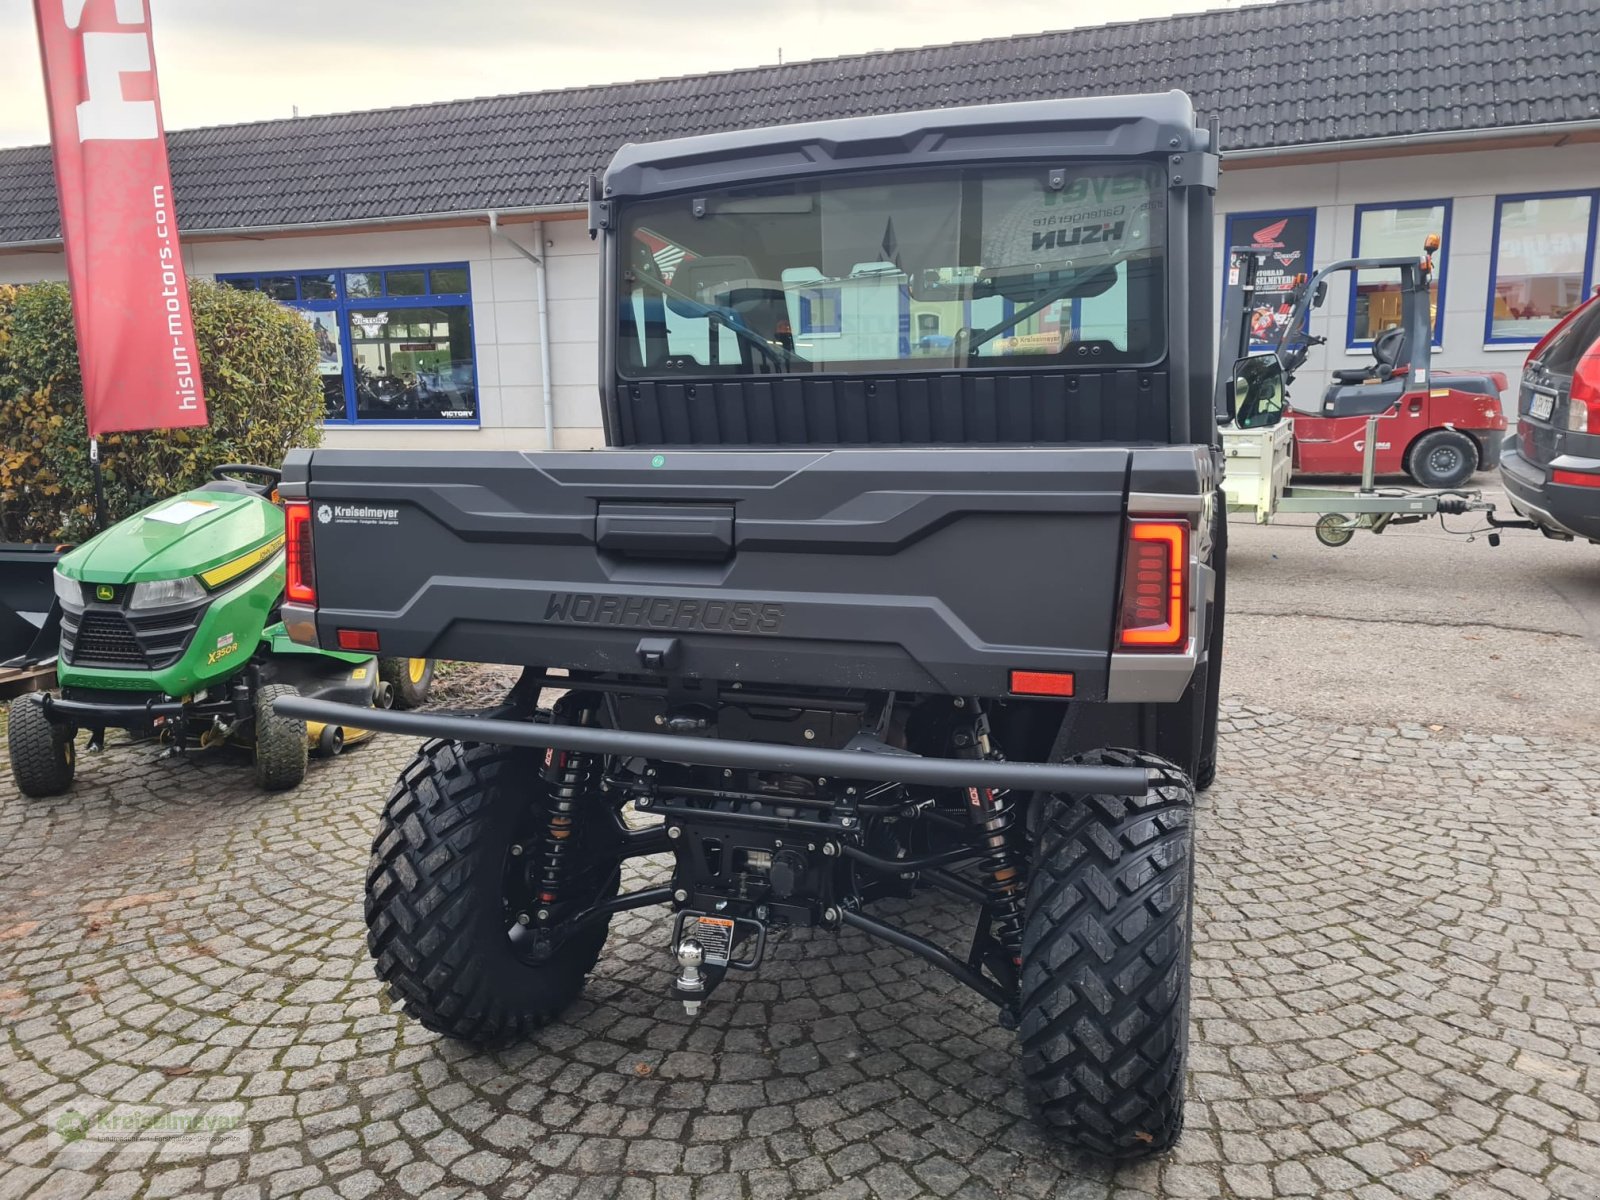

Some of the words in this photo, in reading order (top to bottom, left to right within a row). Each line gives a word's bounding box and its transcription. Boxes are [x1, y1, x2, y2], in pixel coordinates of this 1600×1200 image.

[153, 185, 197, 409] hisun-motors.com
[352, 317, 389, 325] VICTORY
[335, 506, 399, 520] Kreiselmeyer
[543, 592, 785, 634] WORKCROSS
[208, 643, 238, 664] X350R
